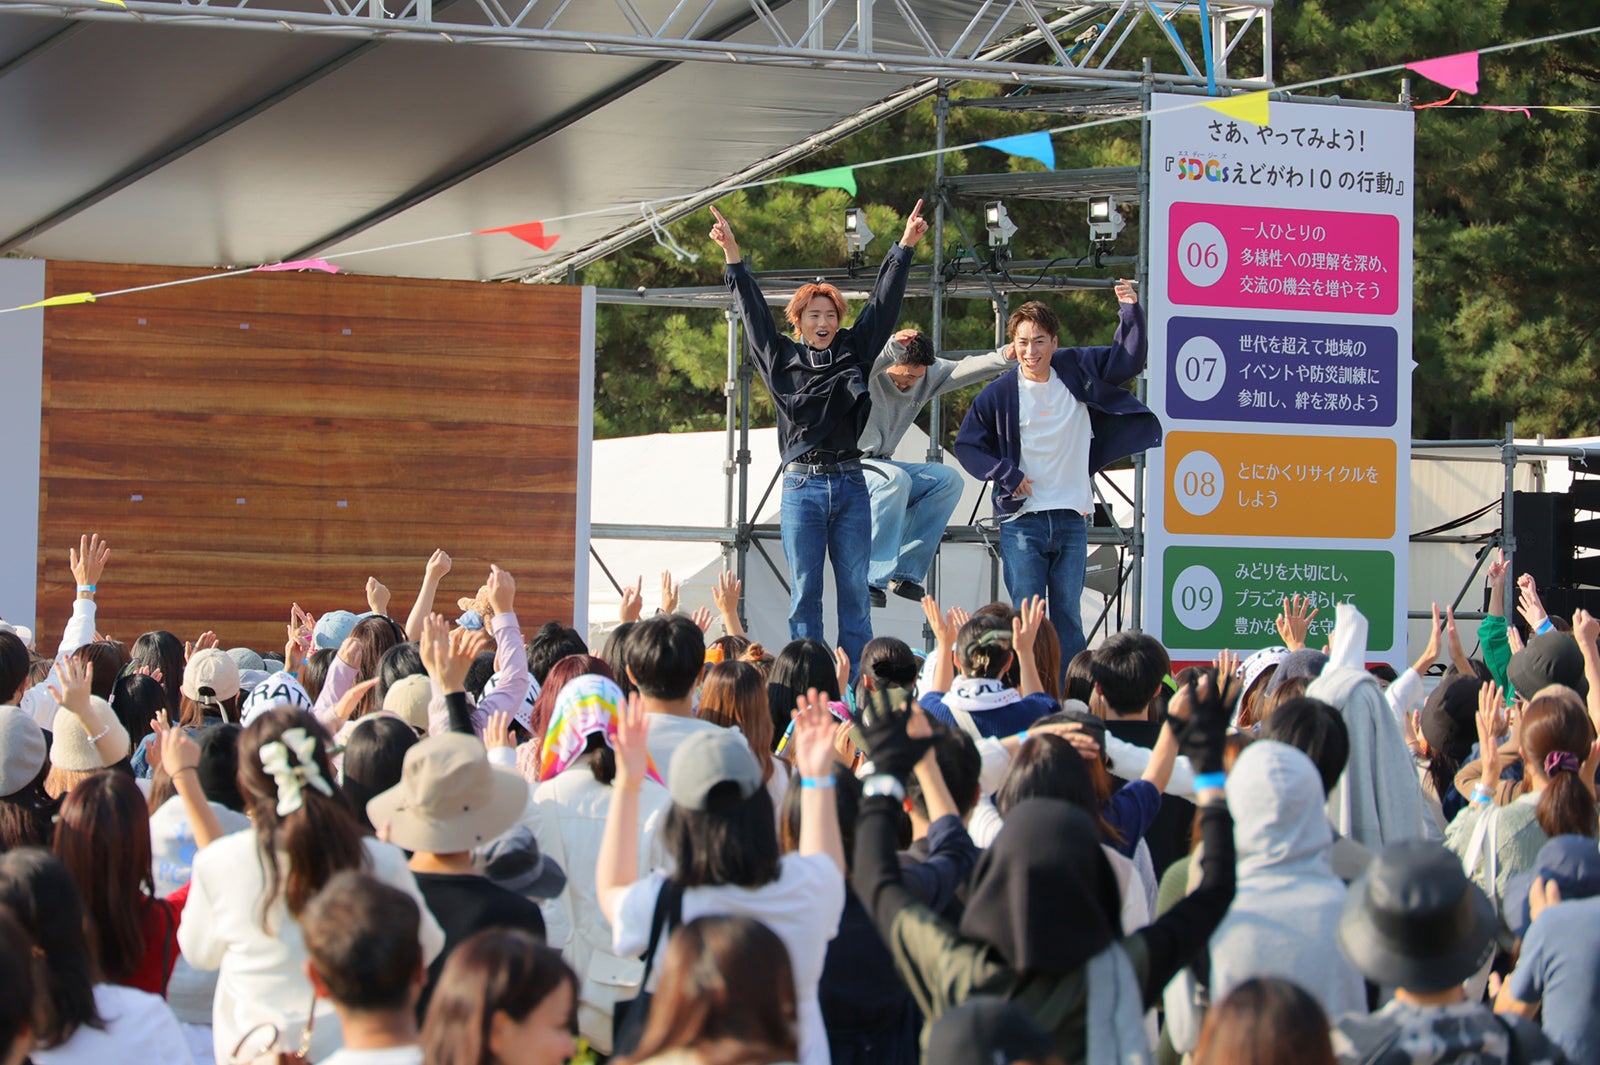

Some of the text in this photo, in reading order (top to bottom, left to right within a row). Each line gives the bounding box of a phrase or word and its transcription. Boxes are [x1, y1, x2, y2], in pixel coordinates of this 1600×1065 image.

[1207, 119, 1366, 152] さあ、やってみよう!
[1240, 221, 1326, 242] 一人ひとりの
[1187, 242, 1219, 269] 06
[1240, 248, 1388, 273] 多様性への理解を深め、
[1240, 275, 1380, 300] 交流の機会を増やそう
[1238, 335, 1367, 357] 世代を超えて地域の
[1185, 356, 1217, 383] 07
[1239, 363, 1380, 385] イベントや防災訓練に
[1237, 389, 1379, 412] 参加し、絆を深めよう
[1183, 471, 1216, 497] 08
[1238, 462, 1379, 484] とにかくリサイクルを
[1238, 490, 1279, 508] しよう
[1234, 562, 1349, 582] みどりを大切にし、
[1181, 586, 1214, 612] 09
